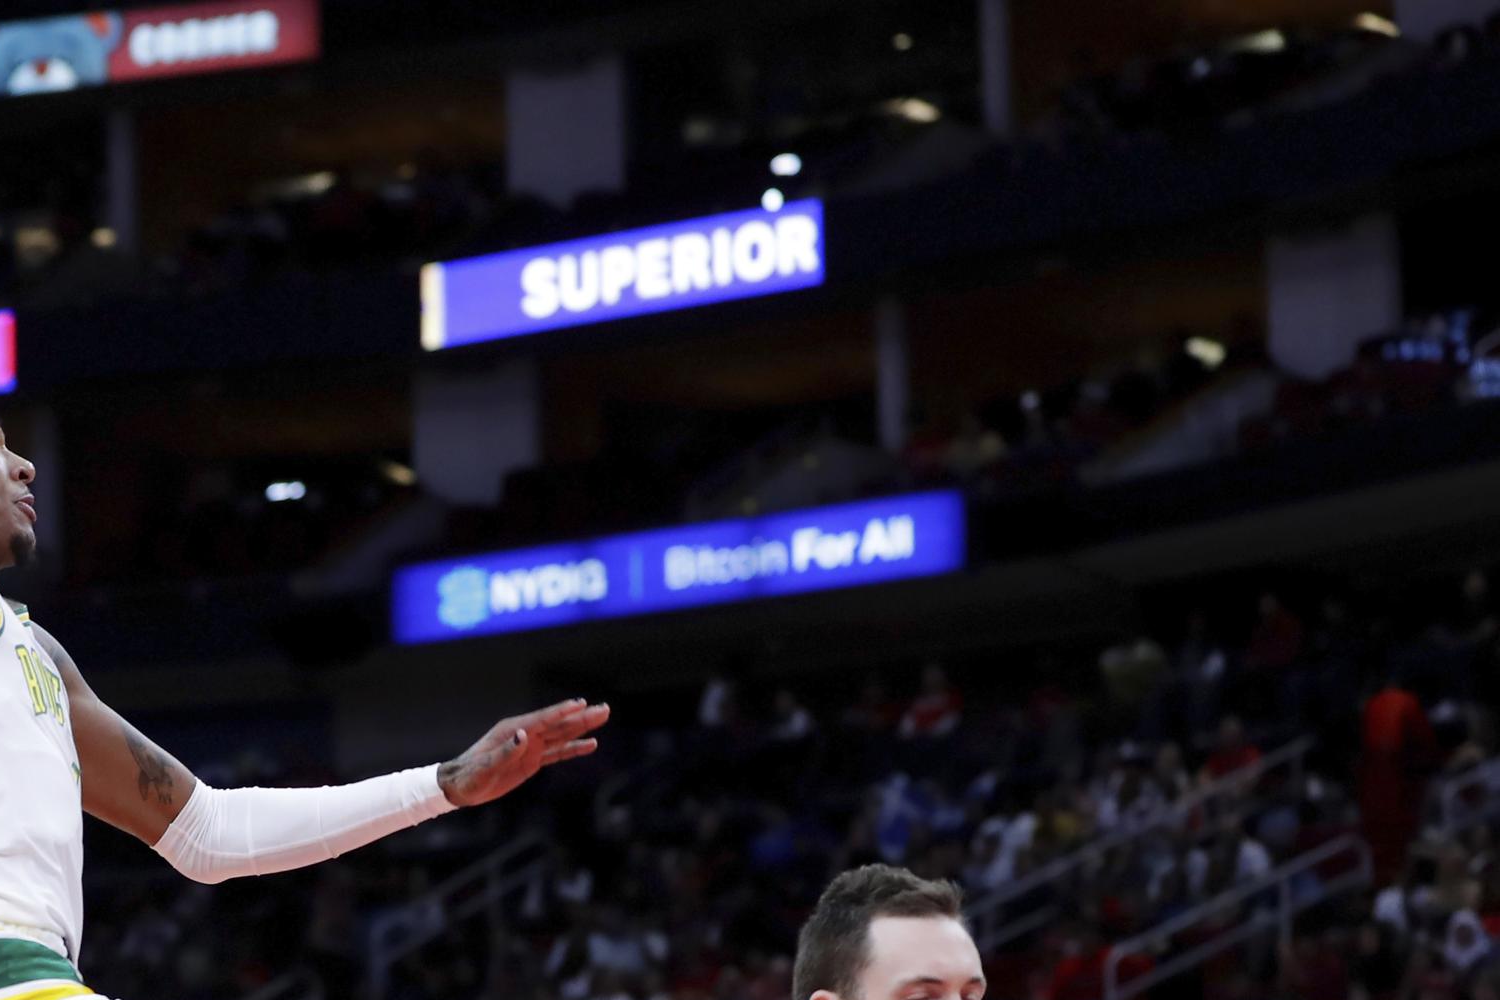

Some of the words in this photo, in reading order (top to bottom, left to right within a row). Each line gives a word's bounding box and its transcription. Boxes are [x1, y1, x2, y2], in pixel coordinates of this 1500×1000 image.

[520, 214, 820, 320] SUPERIOR
[663, 539, 789, 590] Bitcoin
[791, 527, 858, 574] For
[860, 513, 915, 563] All
